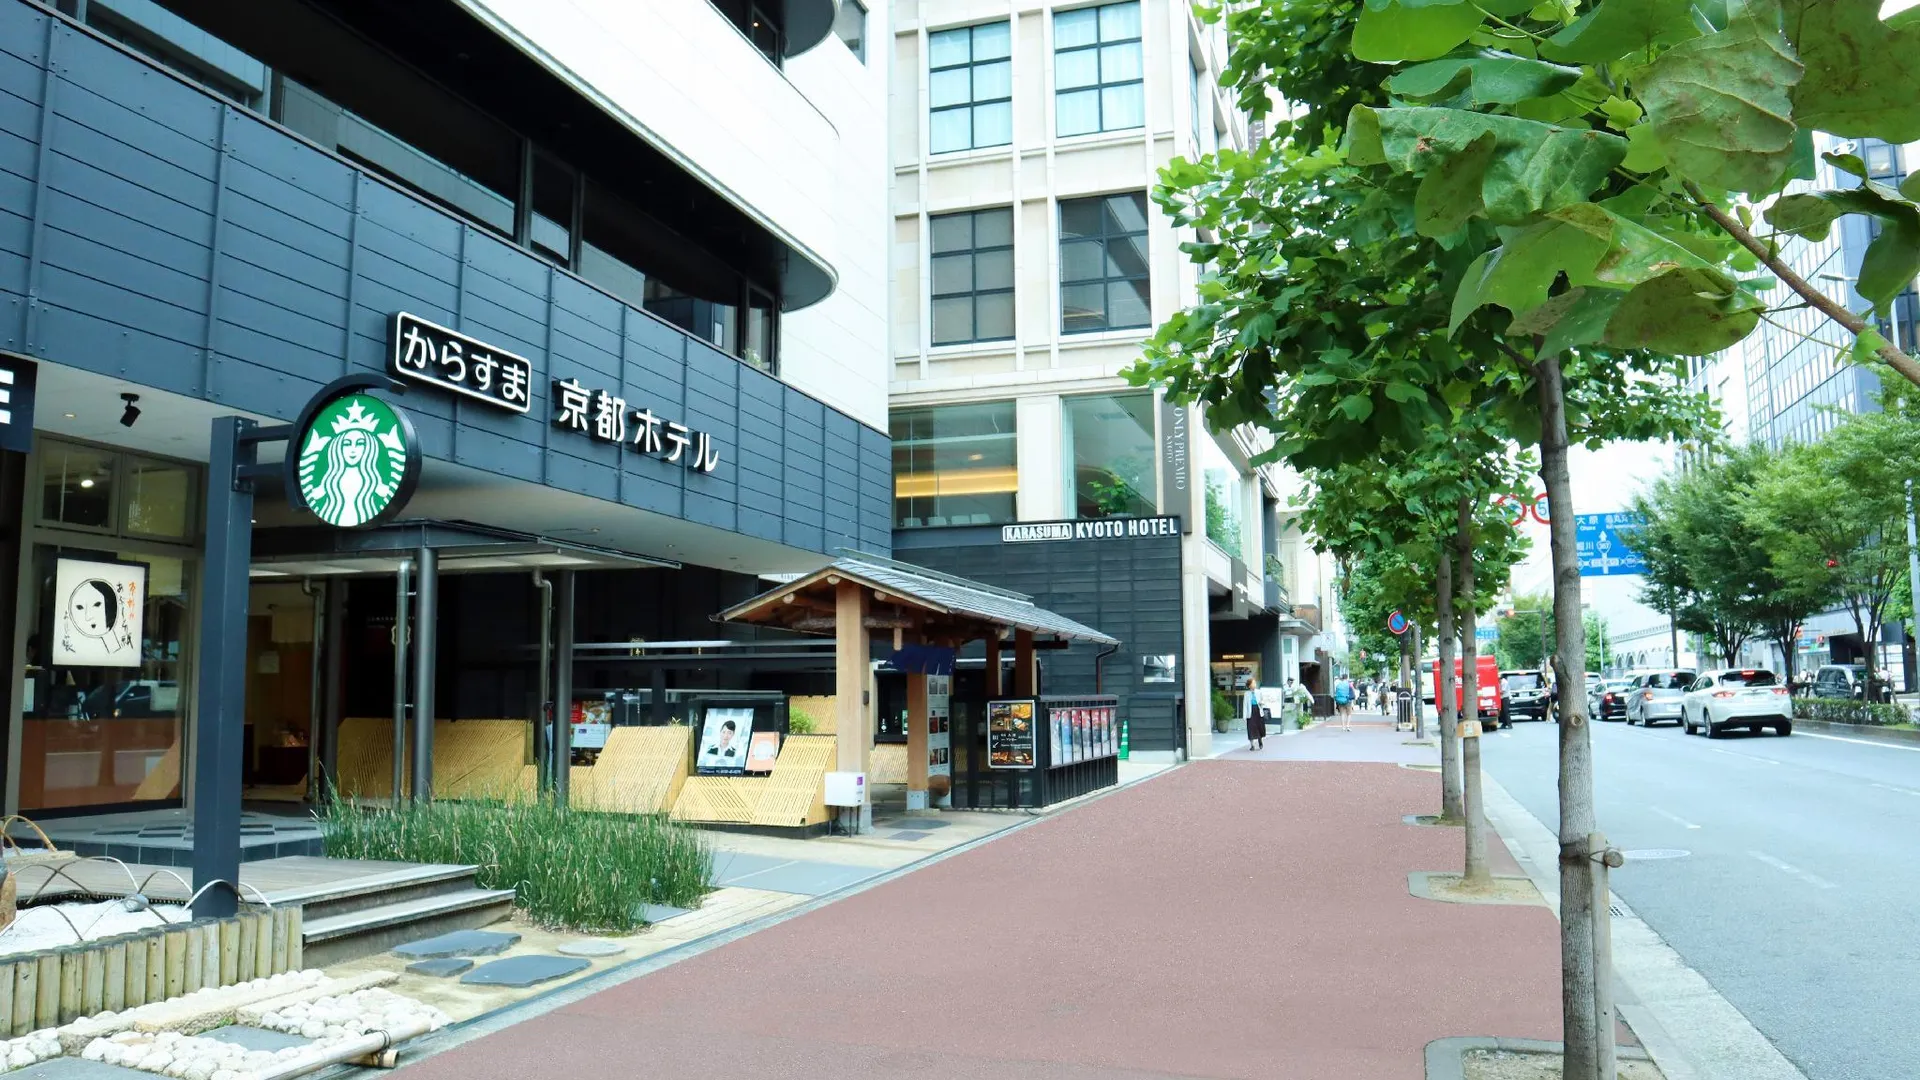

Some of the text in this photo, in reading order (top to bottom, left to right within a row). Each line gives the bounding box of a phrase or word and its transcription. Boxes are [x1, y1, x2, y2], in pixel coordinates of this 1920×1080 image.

[404, 327, 719, 472] からすま 京都ホテル
[1173, 407, 1186, 490] ONLY PREMIO
[1006, 518, 1178, 540] KARASUMA KYOTO HOTEL
